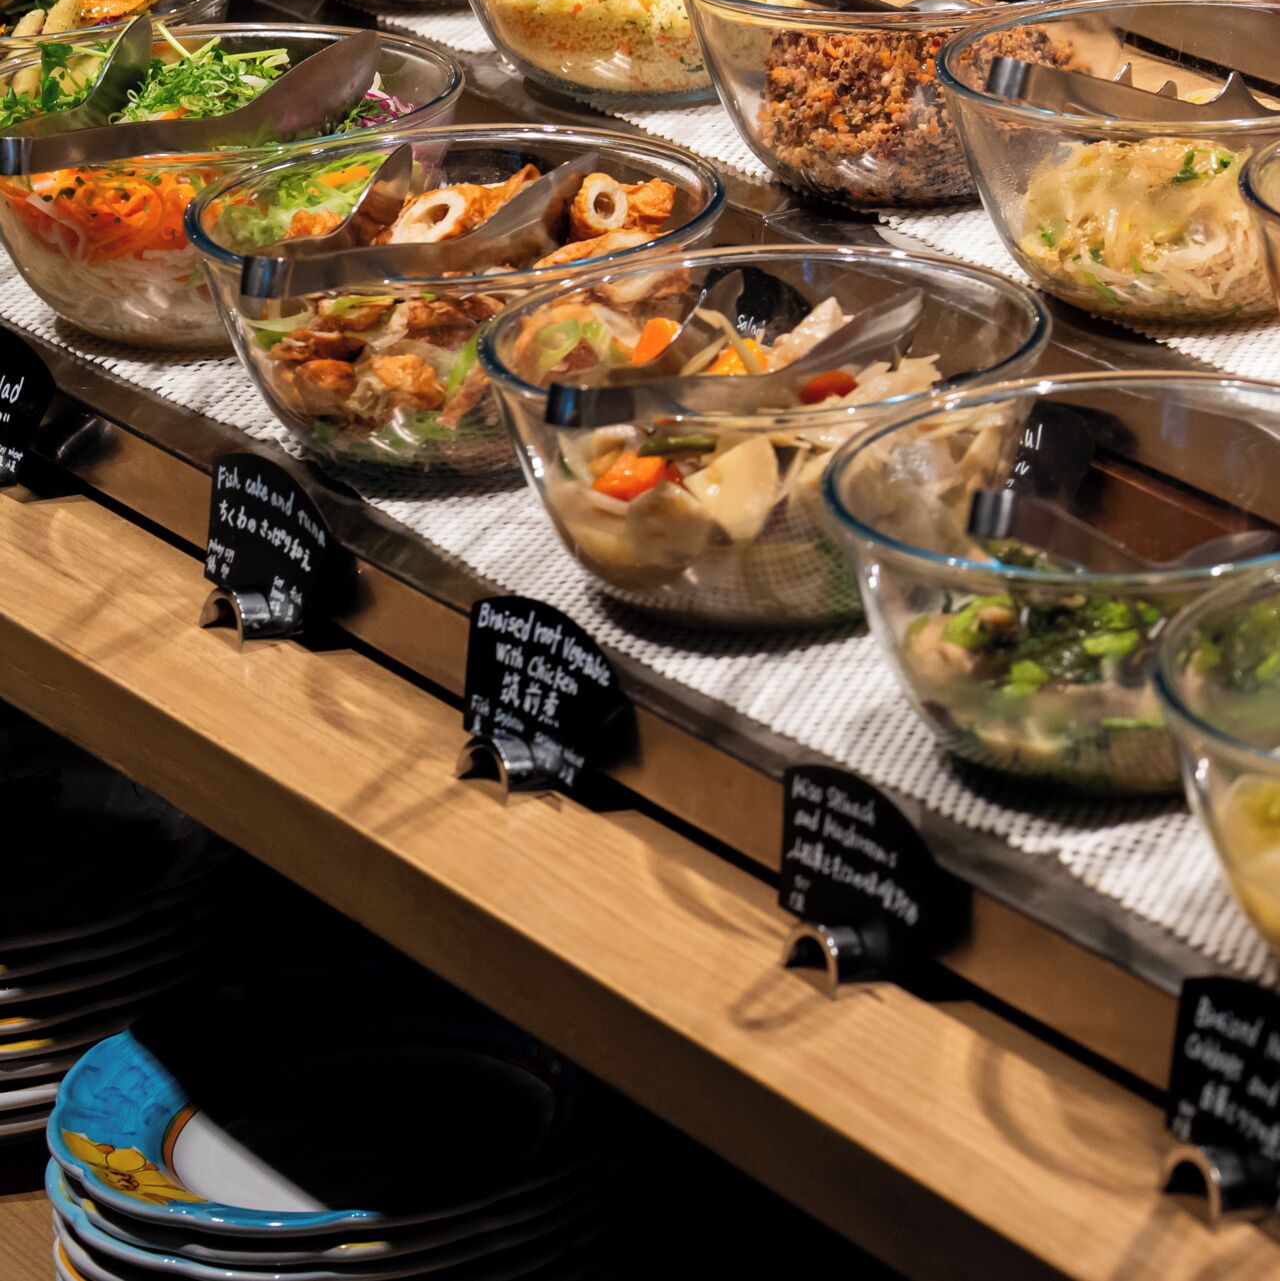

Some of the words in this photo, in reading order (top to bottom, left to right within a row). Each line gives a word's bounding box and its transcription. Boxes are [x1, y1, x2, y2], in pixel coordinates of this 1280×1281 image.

[217, 465, 242, 490] Fish
[245, 474, 269, 502] cake
[270, 491, 295, 517] and
[476, 602, 536, 643] Braised
[526, 655, 579, 697] Chicken
